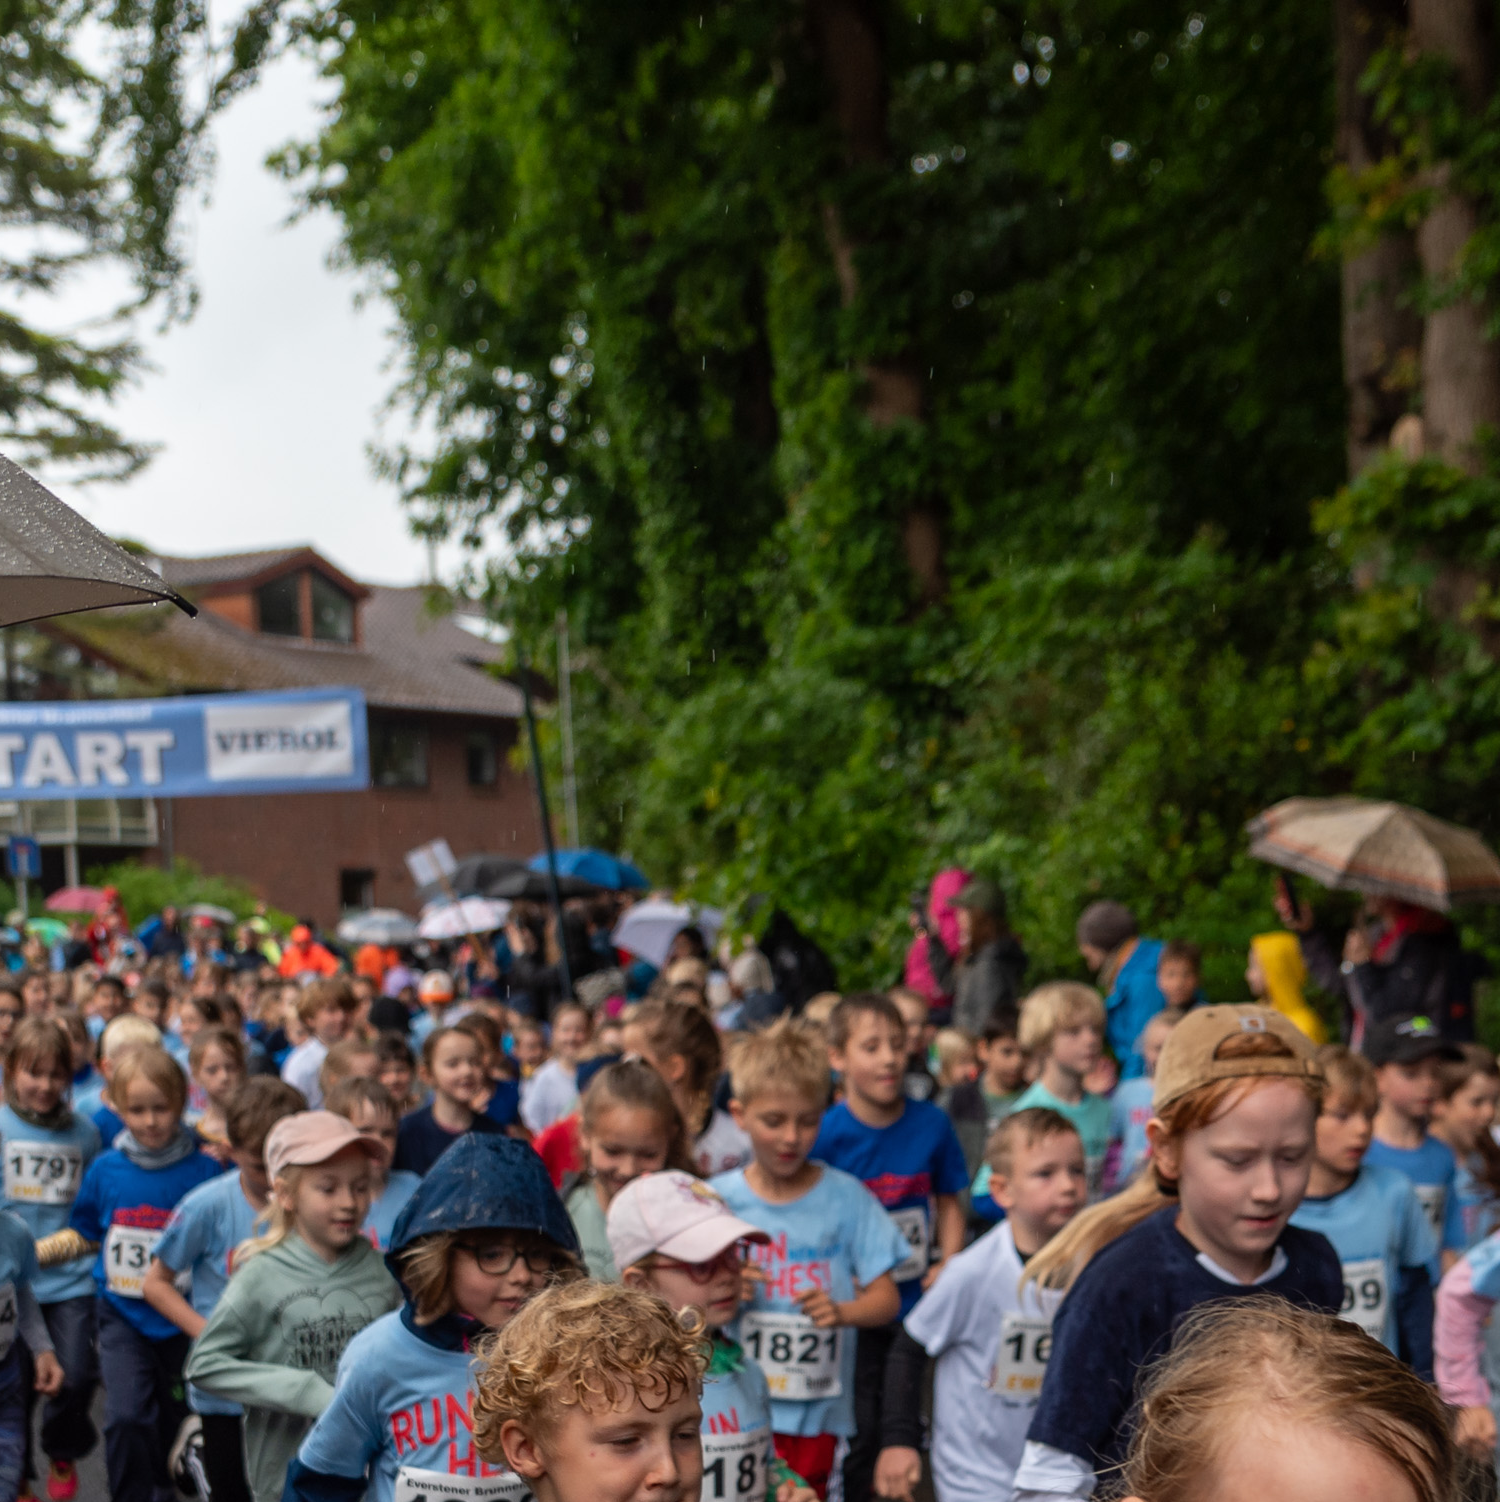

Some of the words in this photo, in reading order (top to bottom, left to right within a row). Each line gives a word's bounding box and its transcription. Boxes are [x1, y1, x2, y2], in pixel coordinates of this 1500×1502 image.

[11, 1155, 81, 1179] 1797
[111, 1241, 155, 1269] 13
[746, 1330, 838, 1364] 1821
[407, 1479, 470, 1496] Everstener
[475, 1484, 530, 1496] Brunnen
[703, 1453, 768, 1499] 18
